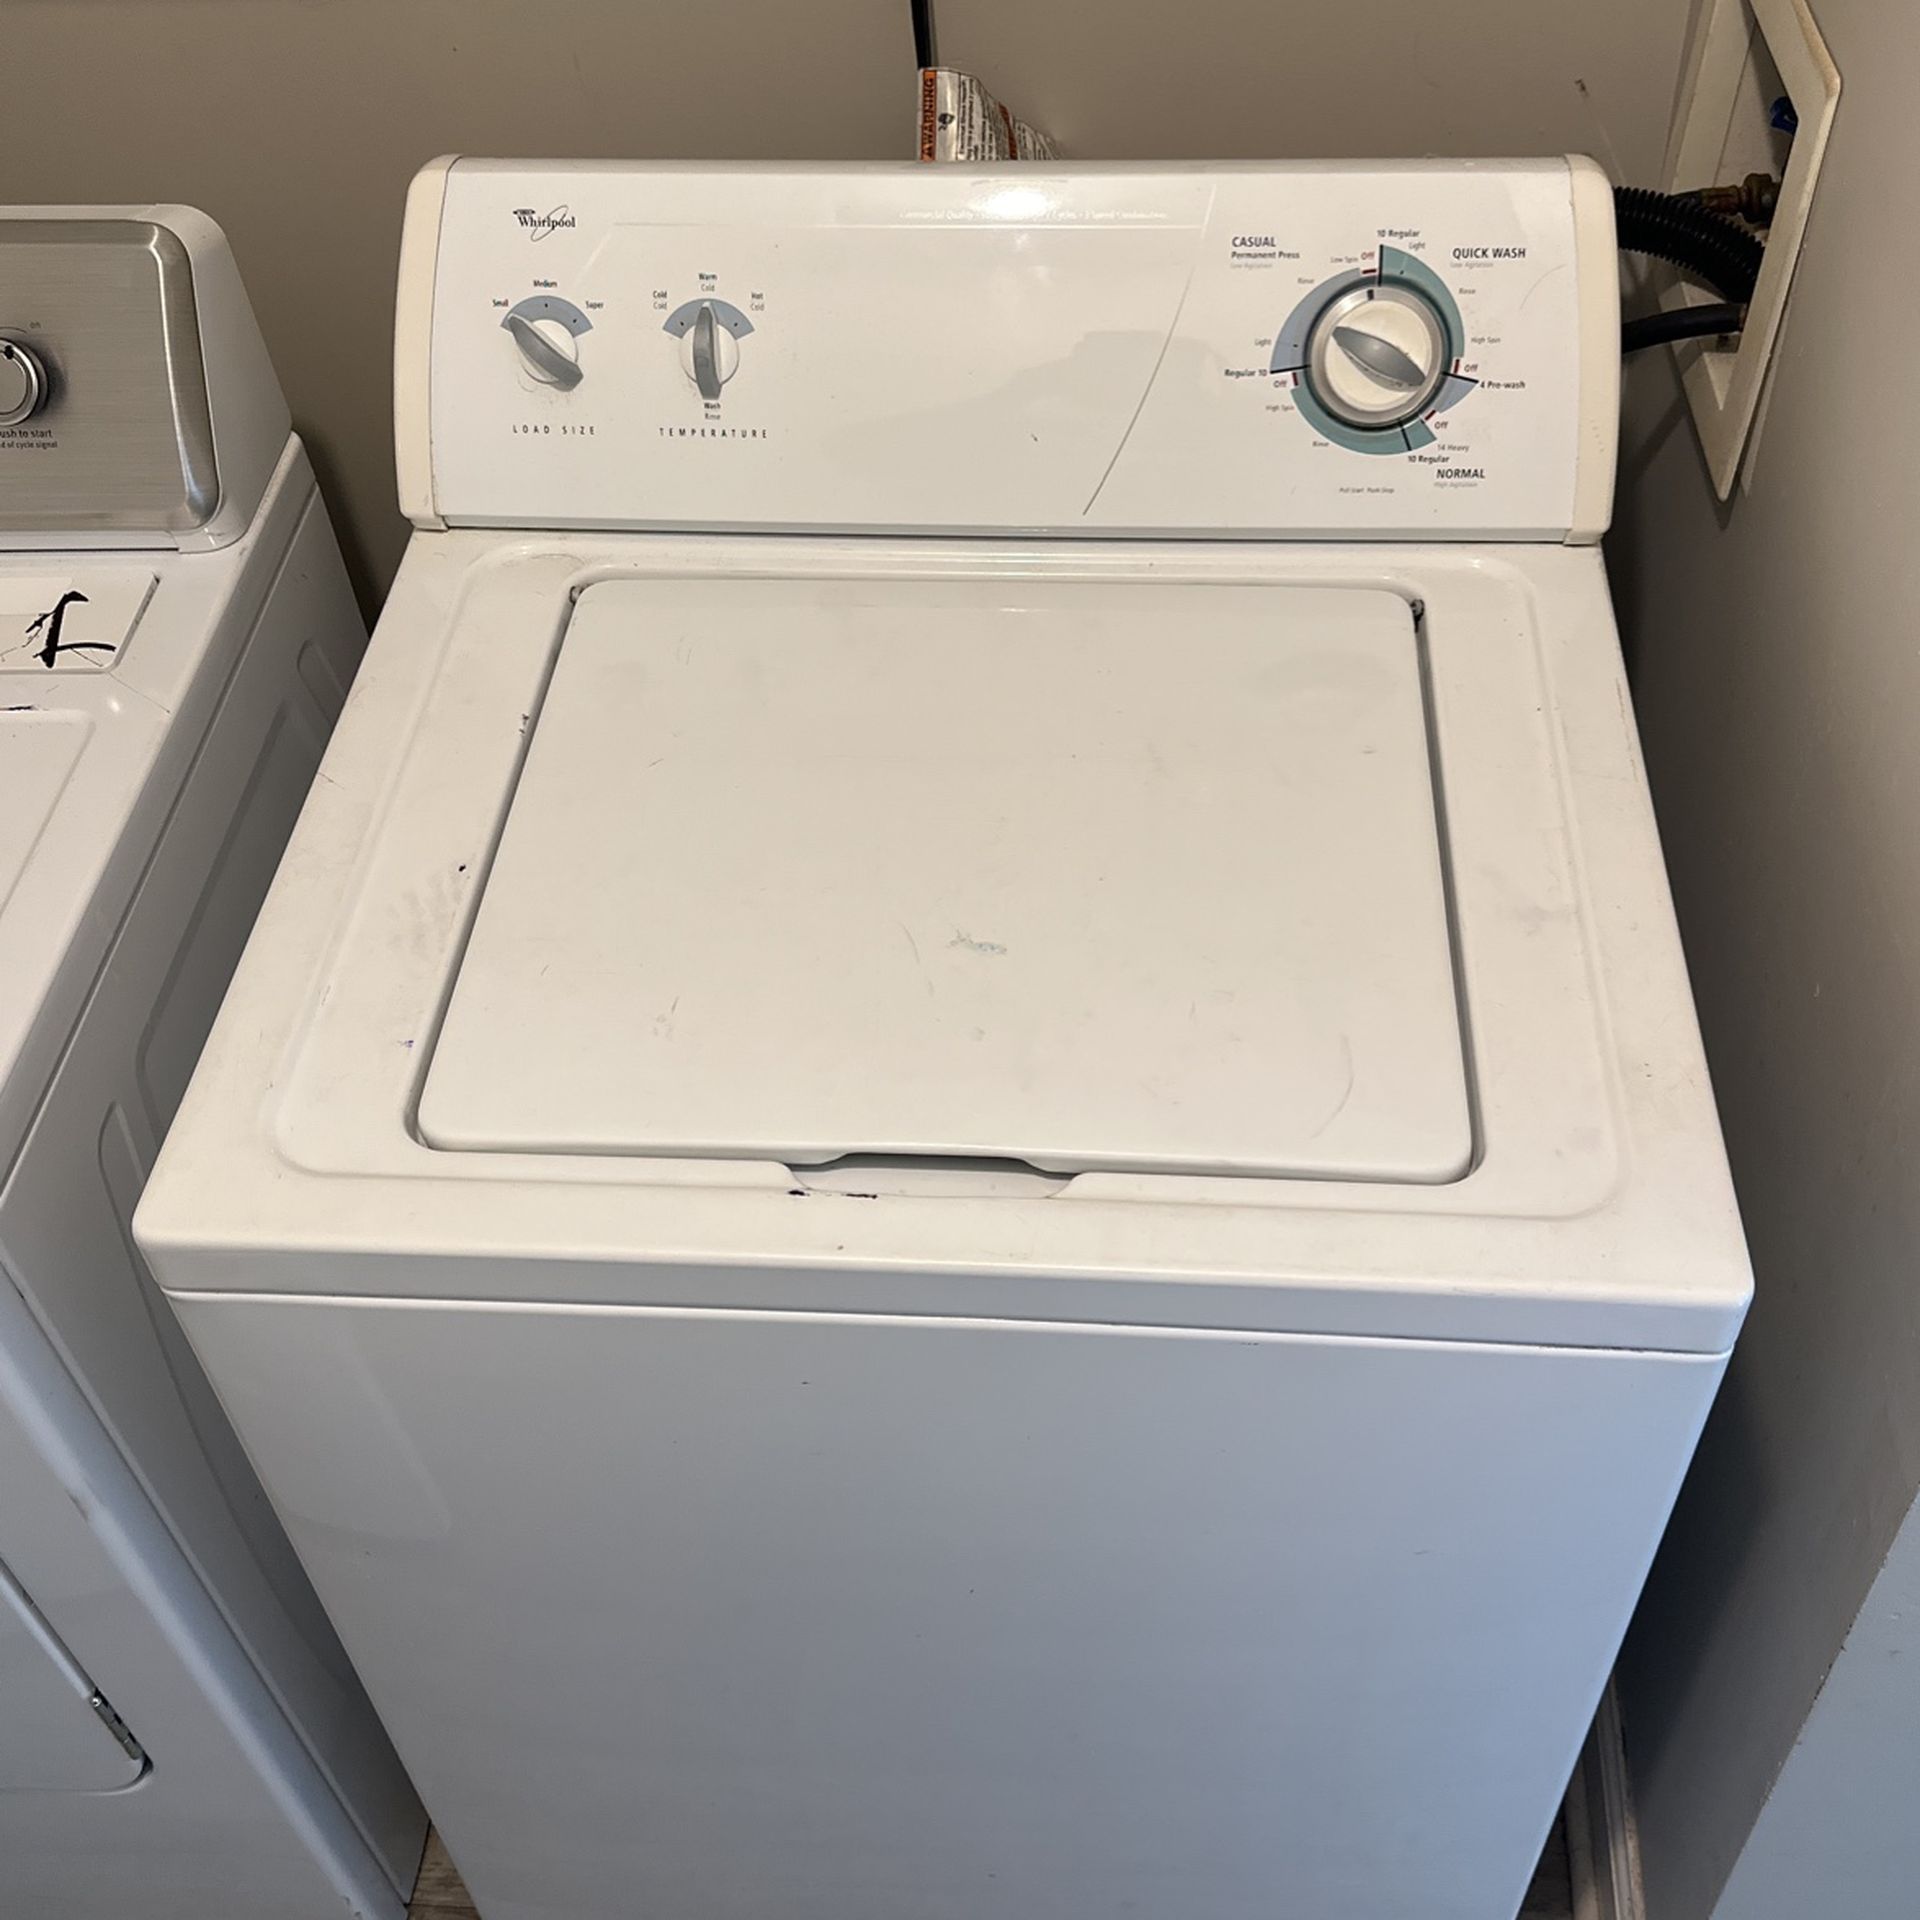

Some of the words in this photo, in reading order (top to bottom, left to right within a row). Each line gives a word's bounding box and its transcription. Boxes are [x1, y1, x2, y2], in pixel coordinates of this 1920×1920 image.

[923, 78, 934, 145] WARNING
[517, 214, 576, 231] Whirlpool
[1377, 230, 1386, 238] 10
[1388, 229, 1421, 240] Regular
[1231, 236, 1277, 248] CASUAL
[1408, 241, 1426, 251] Light
[1231, 251, 1277, 260] Permanent
[1278, 250, 1301, 259] Press
[1361, 251, 1375, 260] Off
[1452, 247, 1488, 260] QUICK
[1491, 247, 1527, 259] WASH
[698, 272, 718, 281] Warm
[533, 279, 558, 288] Medium
[700, 283, 716, 292] Cold
[652, 290, 668, 299] Cold
[751, 292, 764, 300] Hot
[492, 299, 509, 308] Small
[585, 300, 605, 310] Super
[1464, 363, 1479, 373] Off
[1224, 368, 1256, 379] Regular
[1258, 369, 1268, 377] 10
[1273, 380, 1288, 389] Off
[1480, 381, 1486, 389] 4
[1487, 381, 1526, 390] Pre-wash
[703, 402, 721, 410] Wash
[512, 424, 550, 434] LOAD
[561, 425, 595, 435] SIZE
[1434, 420, 1449, 430] Off
[19, 430, 29, 438] to
[31, 430, 53, 438] start
[659, 427, 768, 439] TEMPERATURE
[16, 441, 35, 450] cycle
[1447, 443, 1470, 453] Heavy
[1408, 455, 1417, 463] 10
[1418, 454, 1450, 465] Regular
[1436, 468, 1486, 479] NORMAL
